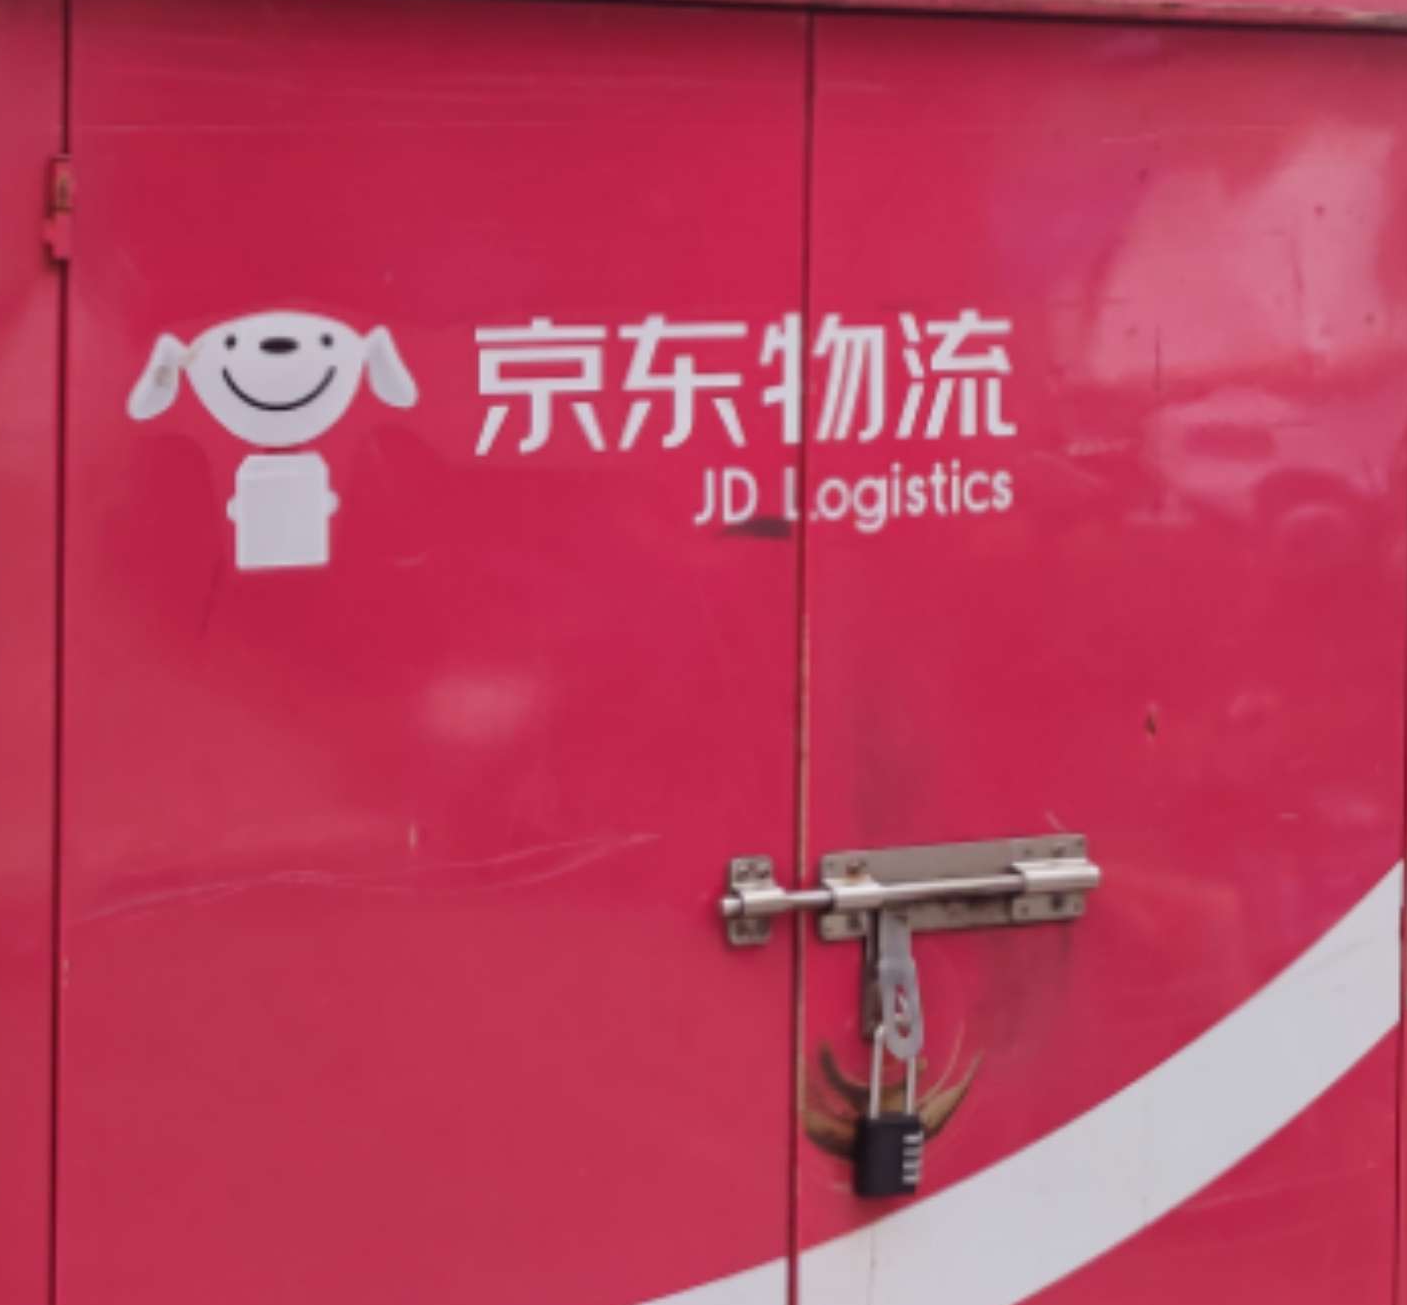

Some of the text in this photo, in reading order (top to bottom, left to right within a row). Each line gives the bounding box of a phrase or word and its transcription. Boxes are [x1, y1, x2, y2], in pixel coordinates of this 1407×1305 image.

[473, 307, 1018, 456] 京东物流
[693, 461, 1014, 535] JD Logistics
